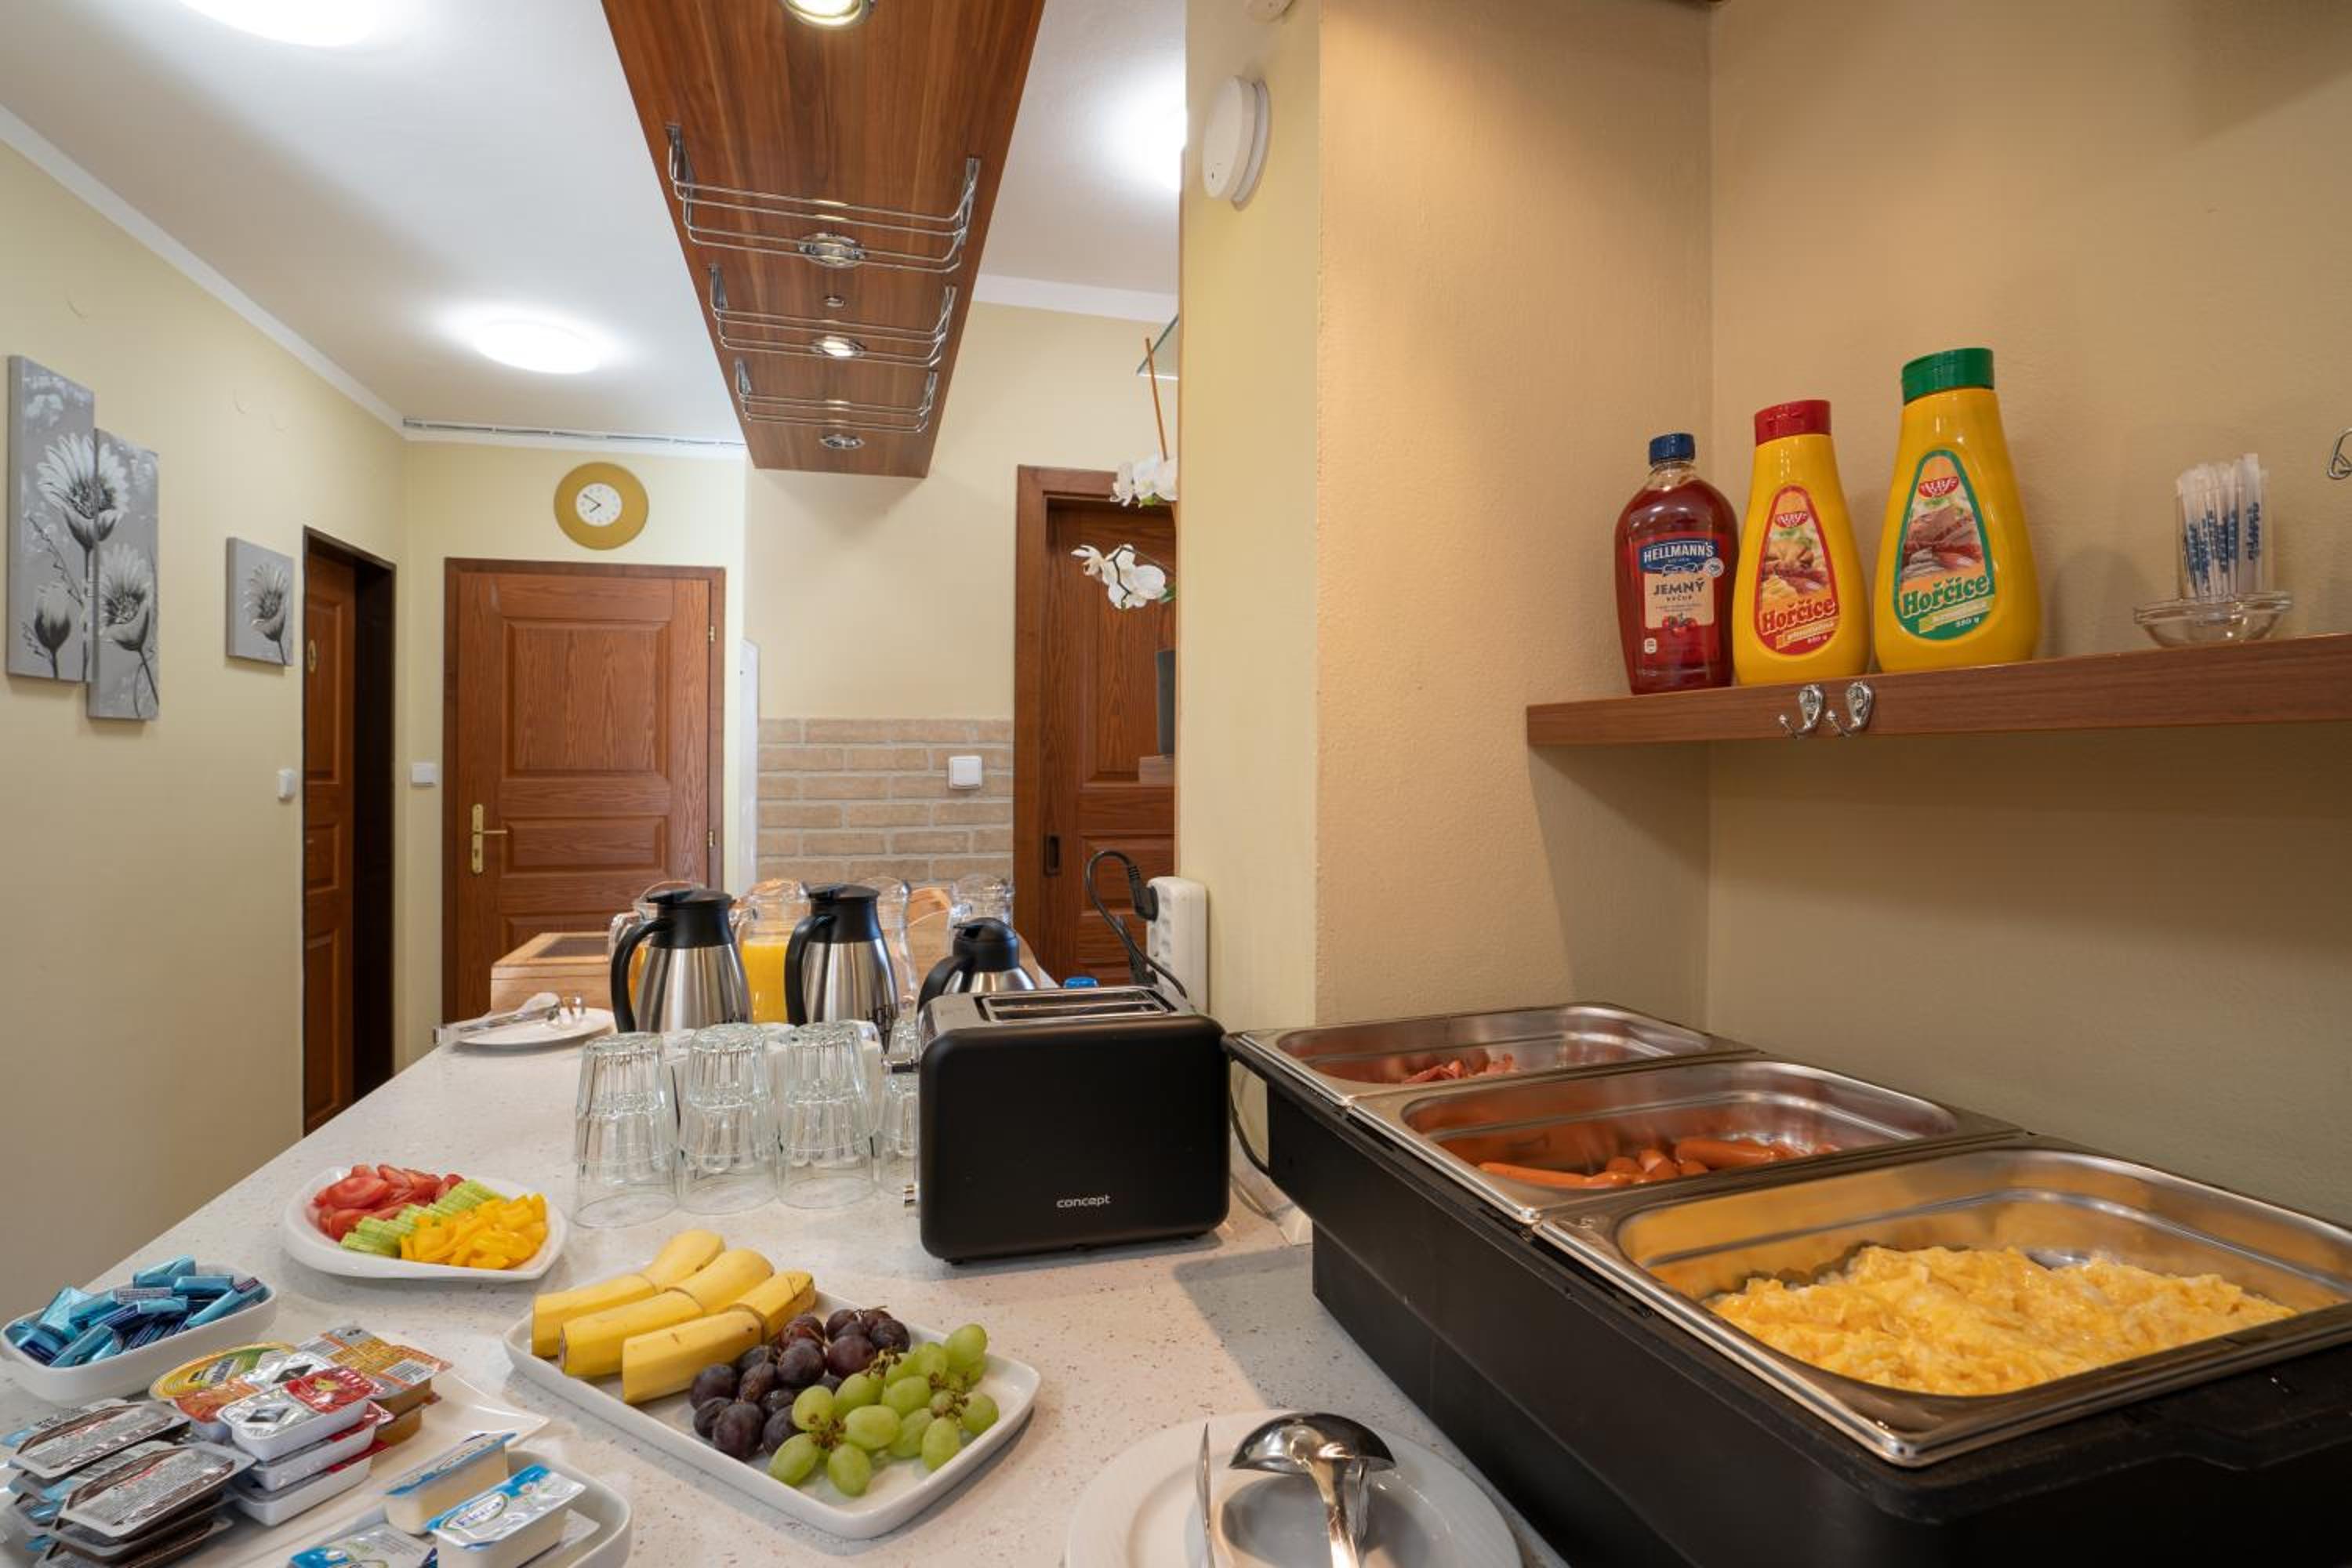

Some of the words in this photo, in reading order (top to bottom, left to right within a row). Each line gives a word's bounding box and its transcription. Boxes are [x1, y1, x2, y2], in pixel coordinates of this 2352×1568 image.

[1643, 541, 1714, 563] HELLMANN'S
[1653, 578, 1704, 595] JEMNÝ
[1902, 575, 1988, 617] Hořčice
[1762, 598, 1836, 633] Hořčice
[1056, 1194, 1111, 1207] concept
